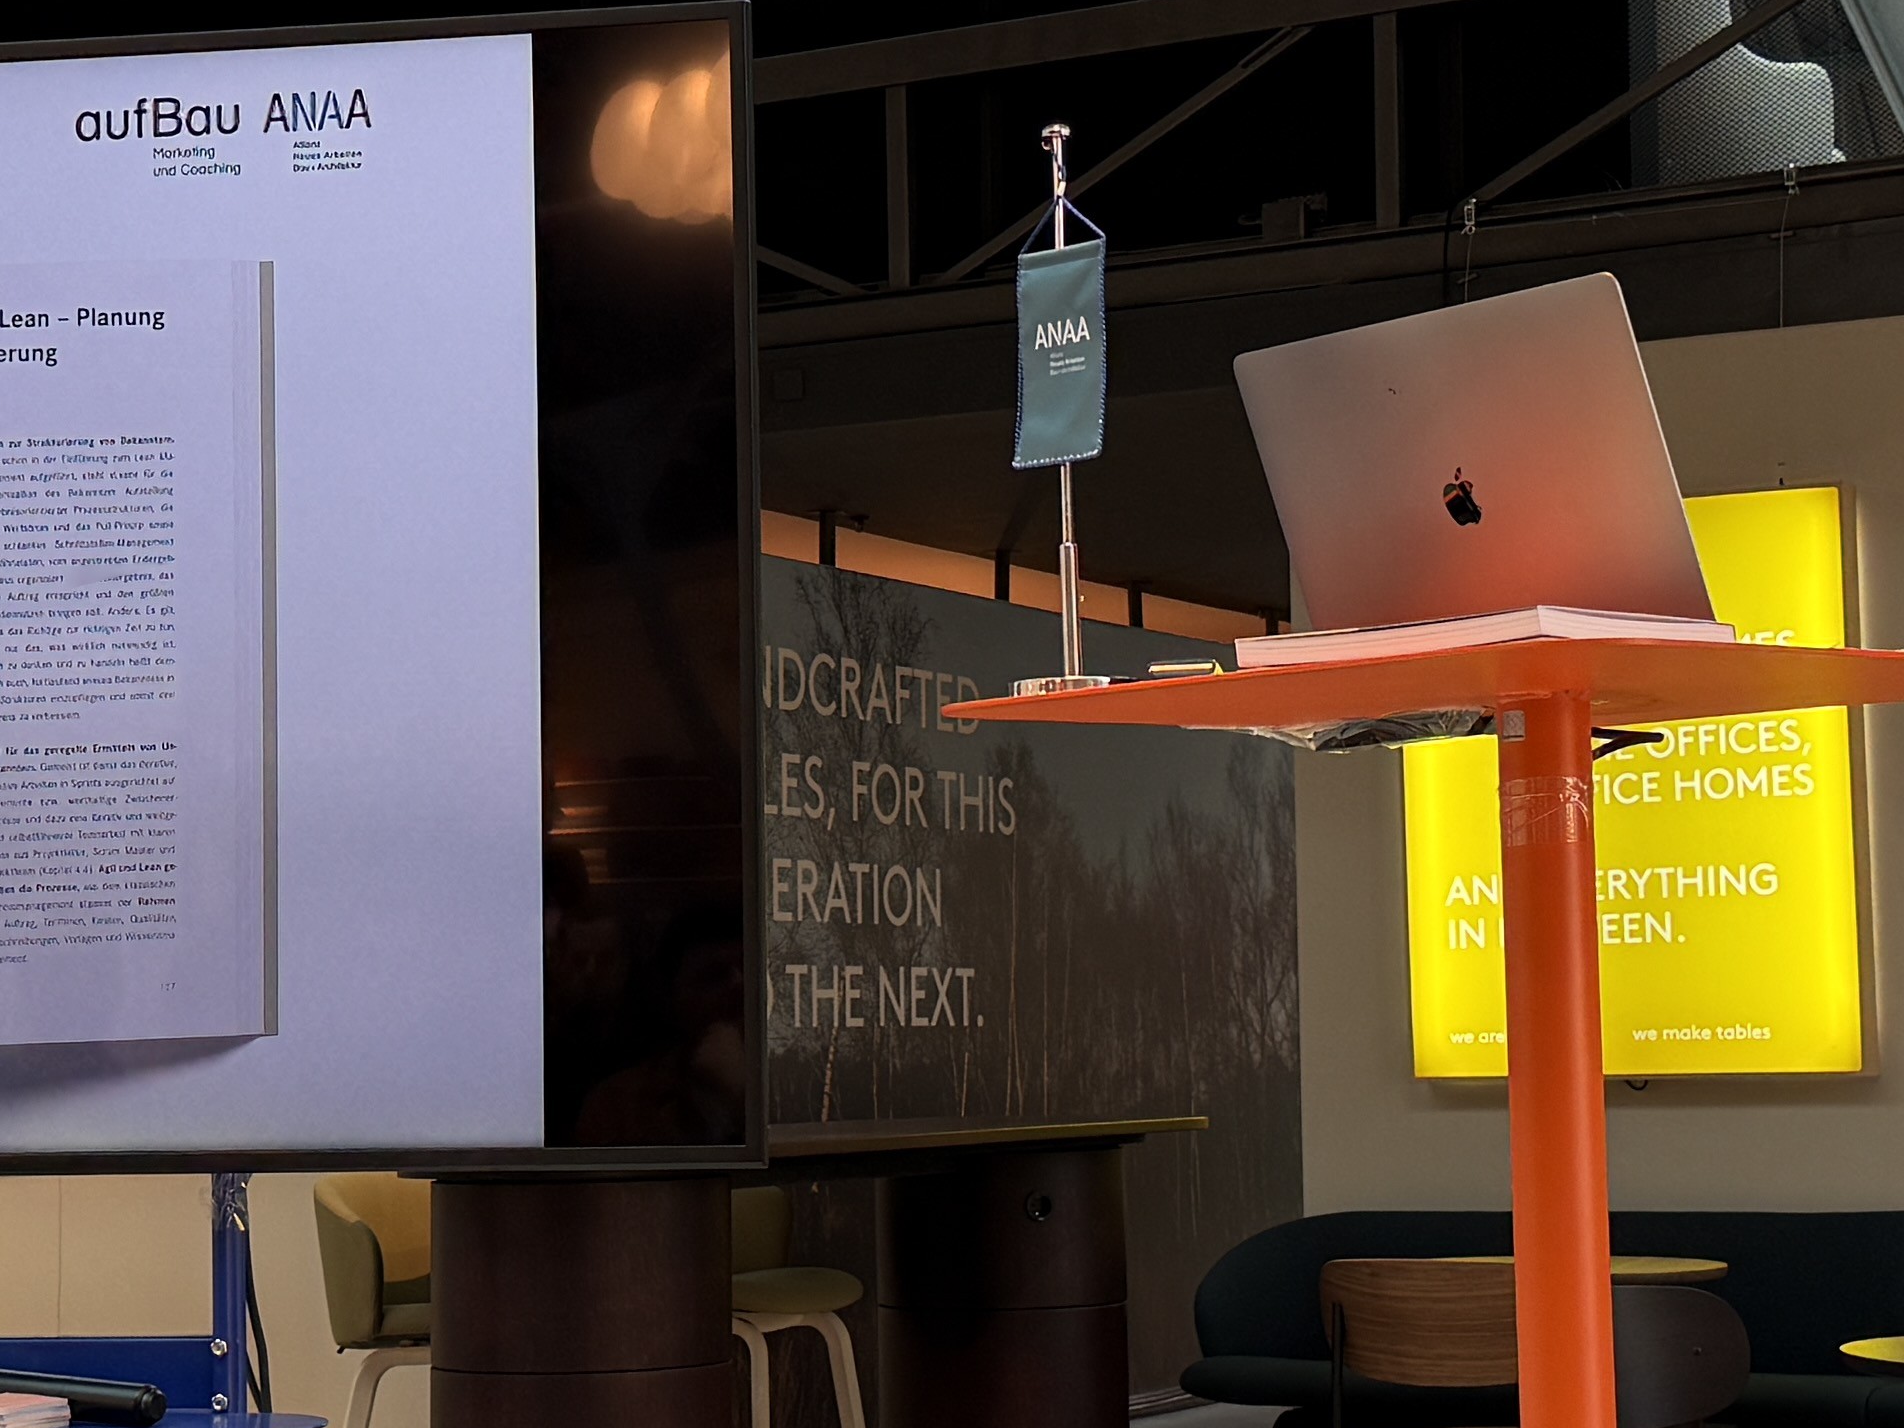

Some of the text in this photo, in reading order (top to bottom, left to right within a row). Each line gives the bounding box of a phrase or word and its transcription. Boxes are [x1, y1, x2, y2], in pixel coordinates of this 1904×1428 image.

[75, 88, 372, 141] aufBau ANAA
[153, 162, 241, 176] und Coaching
[76, 307, 166, 331] Planung
[1035, 316, 1090, 350] ANAA
[1646, 719, 1812, 759] OFFICES,
[852, 760, 928, 829] FOR
[937, 770, 1016, 836] THIS
[1674, 762, 1814, 801] HOMES
[772, 857, 944, 928] ERATION
[1448, 917, 1486, 950] IN
[1601, 911, 1686, 945] EEN.
[784, 963, 865, 1029] THE
[877, 967, 985, 1029] NEXT.
[1450, 1031, 1505, 1045] we are
[1632, 1022, 1771, 1042] we make tables
